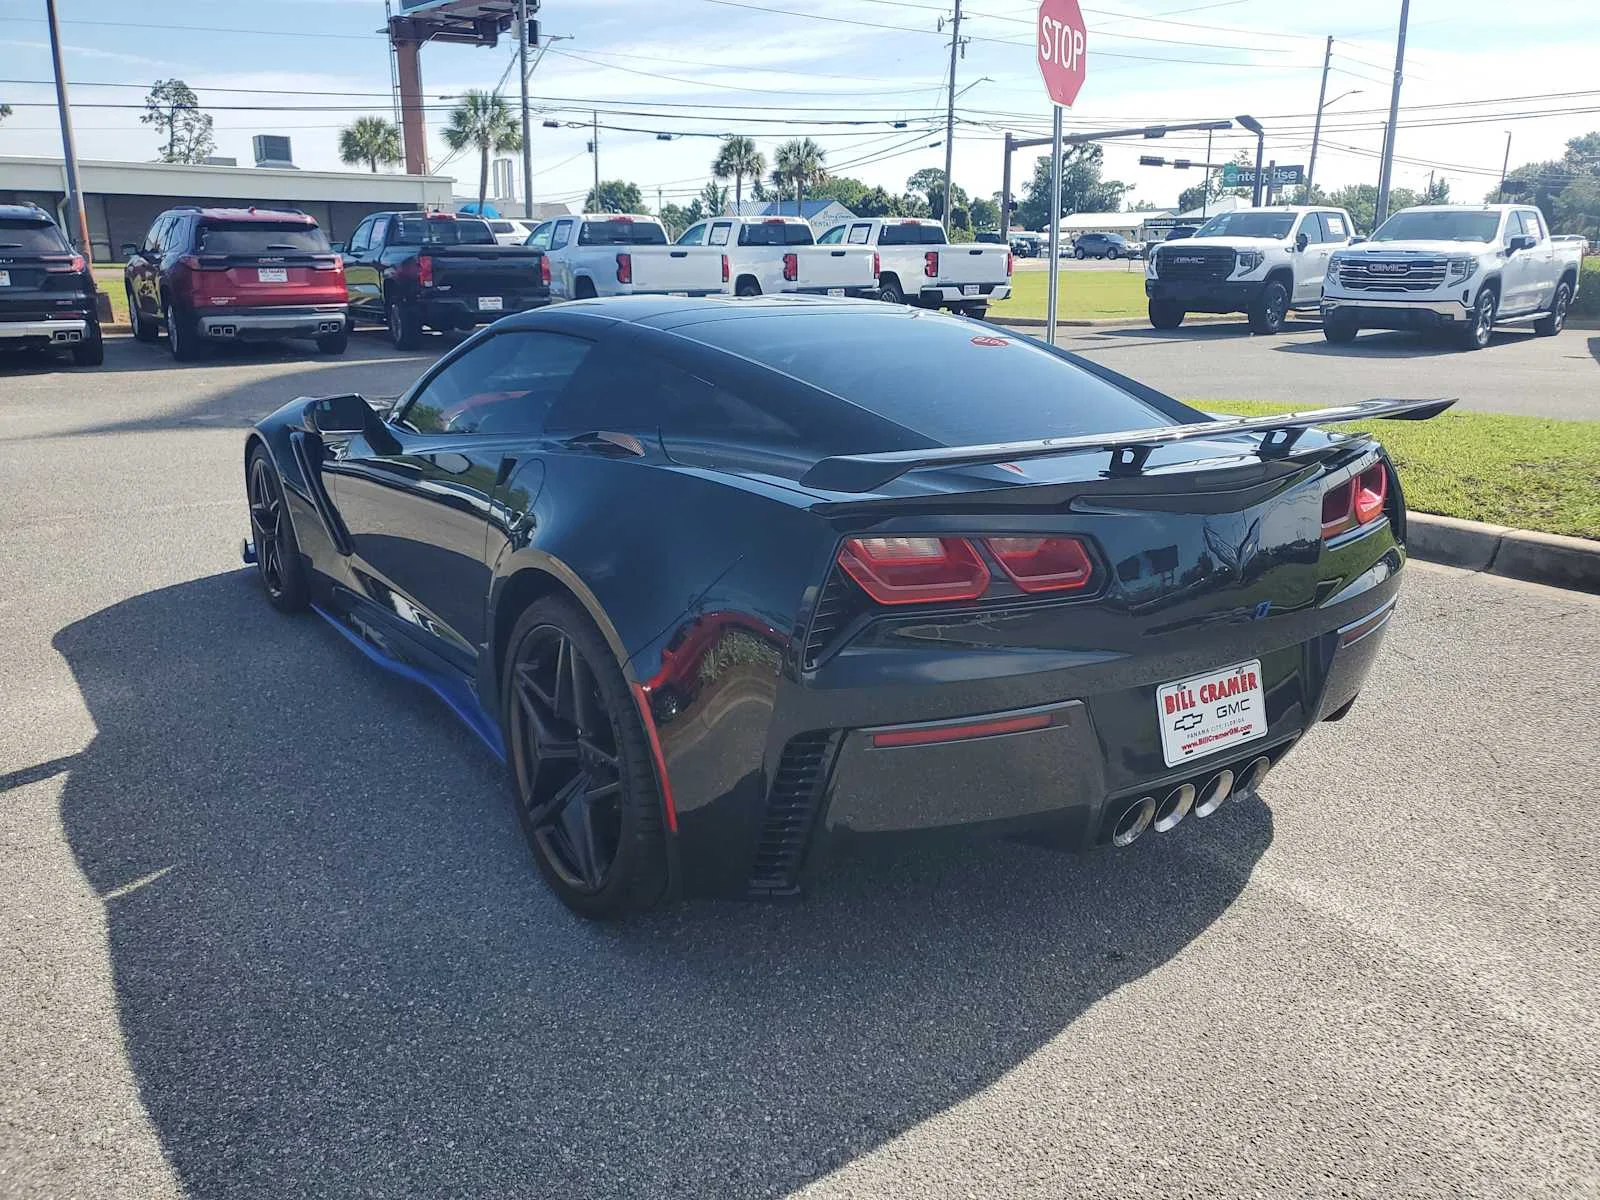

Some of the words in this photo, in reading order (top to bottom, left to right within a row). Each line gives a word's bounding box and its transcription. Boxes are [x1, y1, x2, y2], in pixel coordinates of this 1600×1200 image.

[1041, 15, 1084, 71] STOP
[1369, 263, 1408, 272] GMC
[1165, 691, 1196, 714] BILL
[1200, 672, 1257, 703] CRAMER
[1217, 699, 1250, 718] GMC
[1187, 728, 1210, 739] PANAMA
